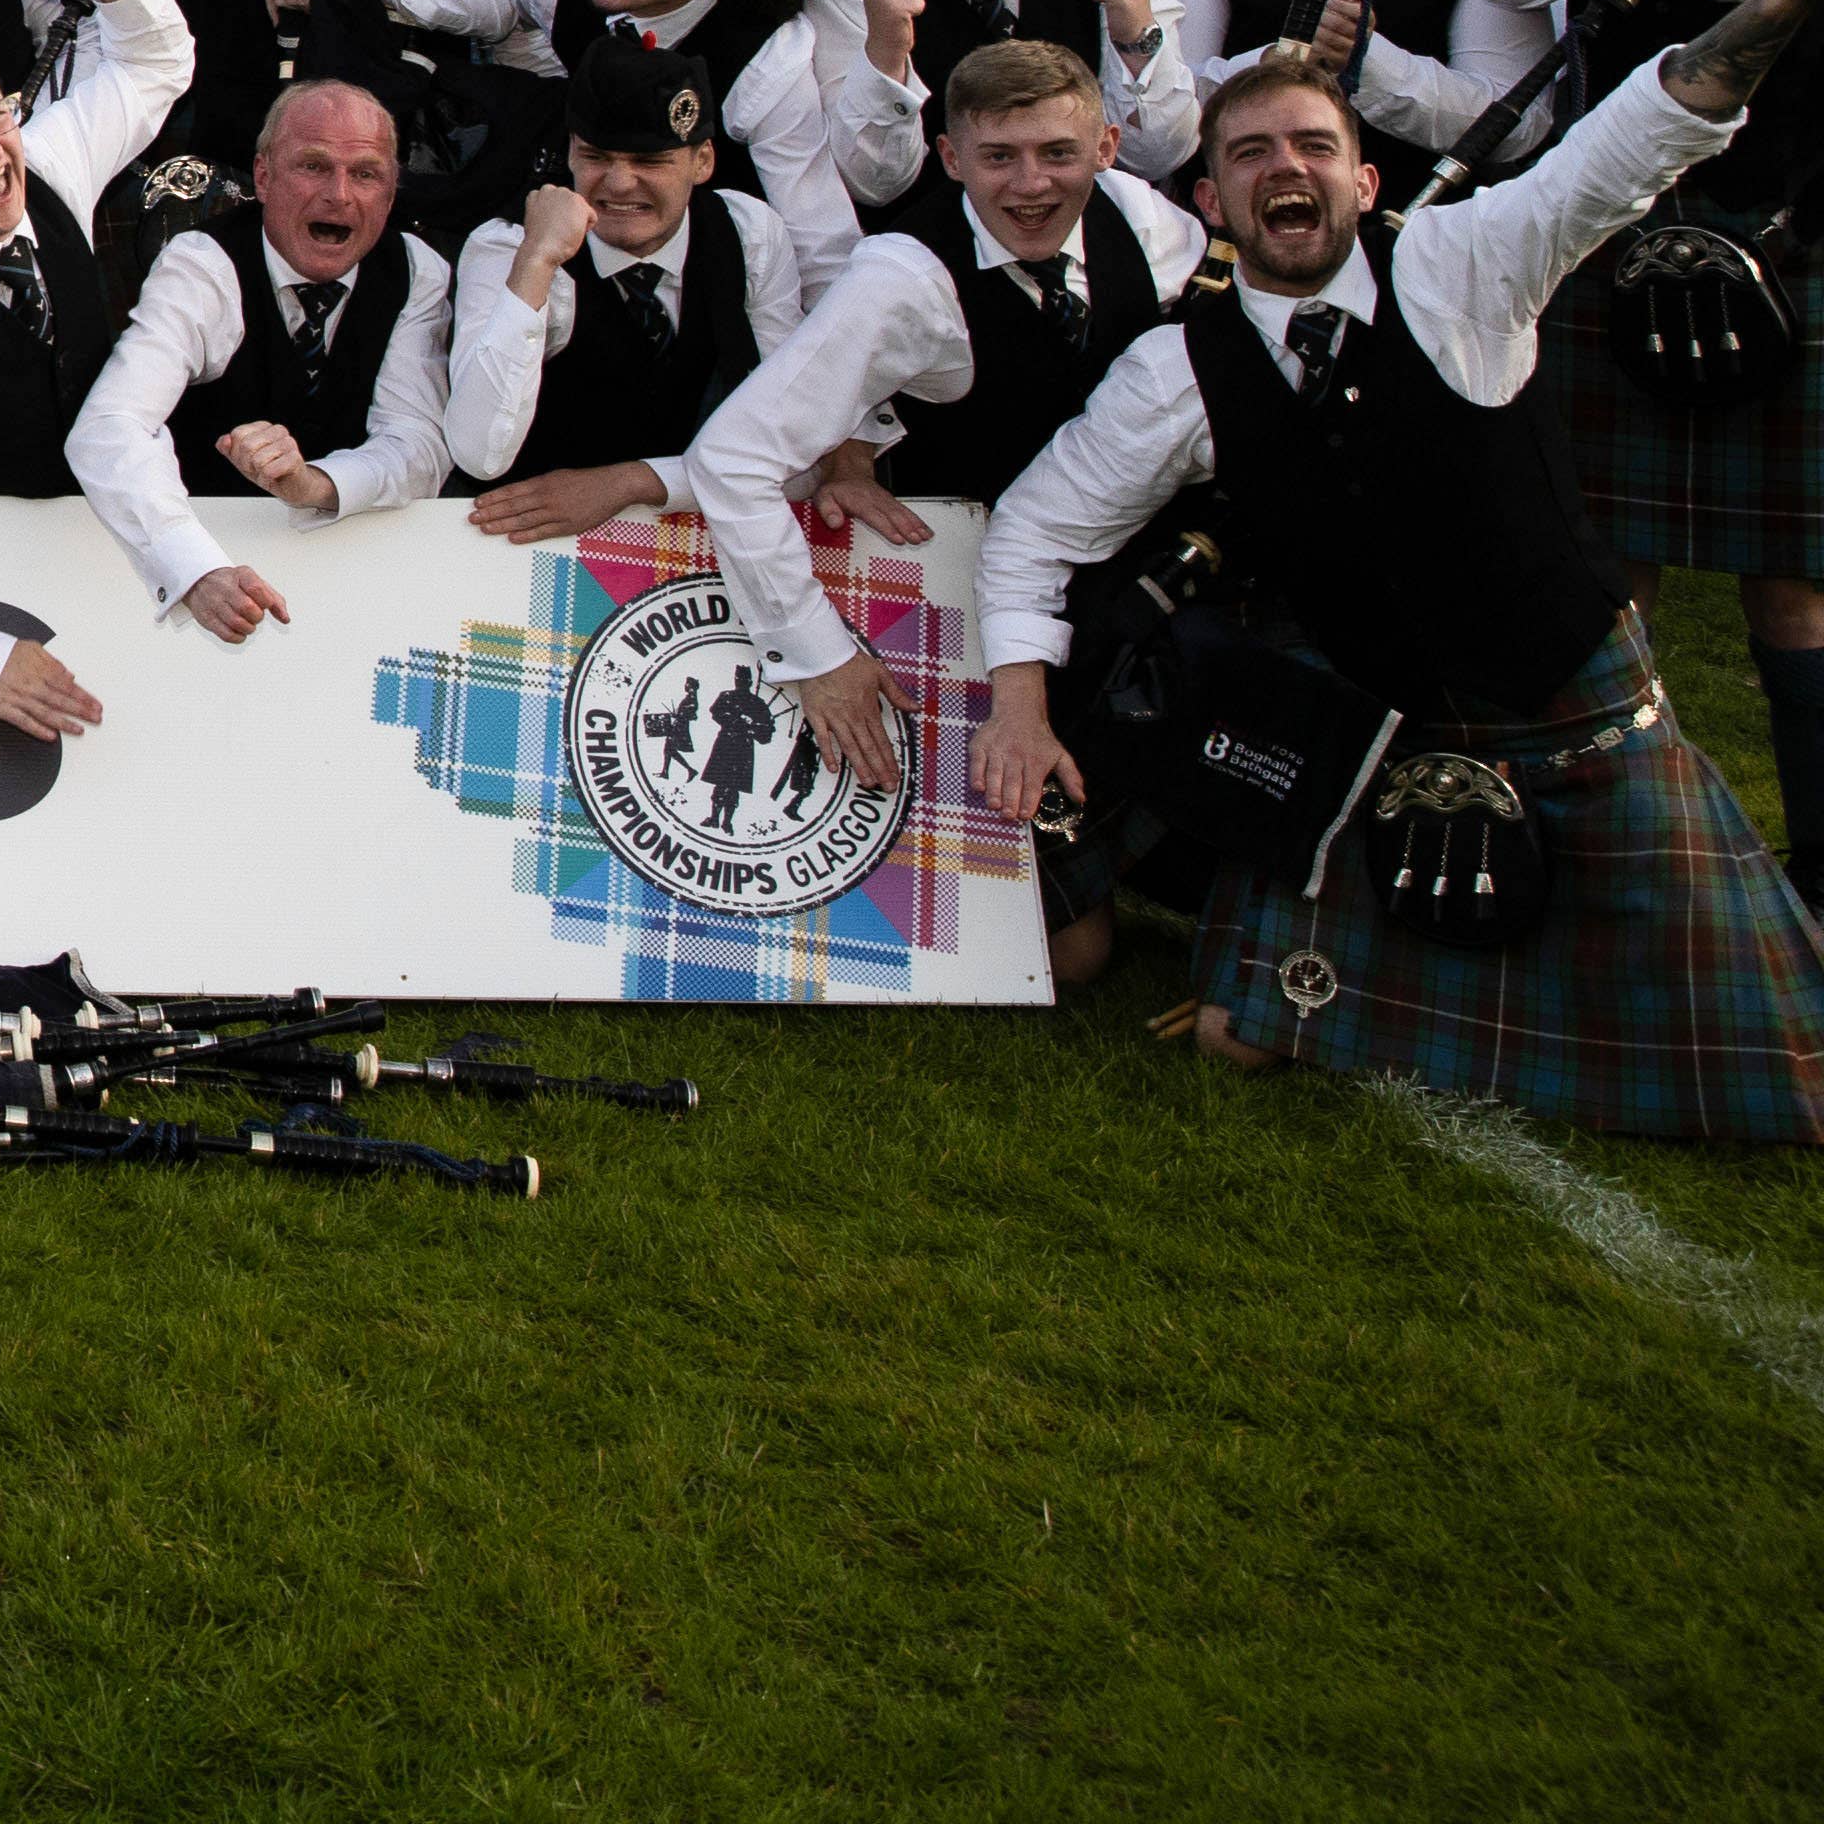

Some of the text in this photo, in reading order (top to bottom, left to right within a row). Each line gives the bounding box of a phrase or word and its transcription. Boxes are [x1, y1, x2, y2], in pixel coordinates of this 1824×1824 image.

[620, 594, 730, 658] WORLD
[585, 709, 777, 894] CHAMPIONSHIPS
[1229, 754, 1292, 790] Bathgate
